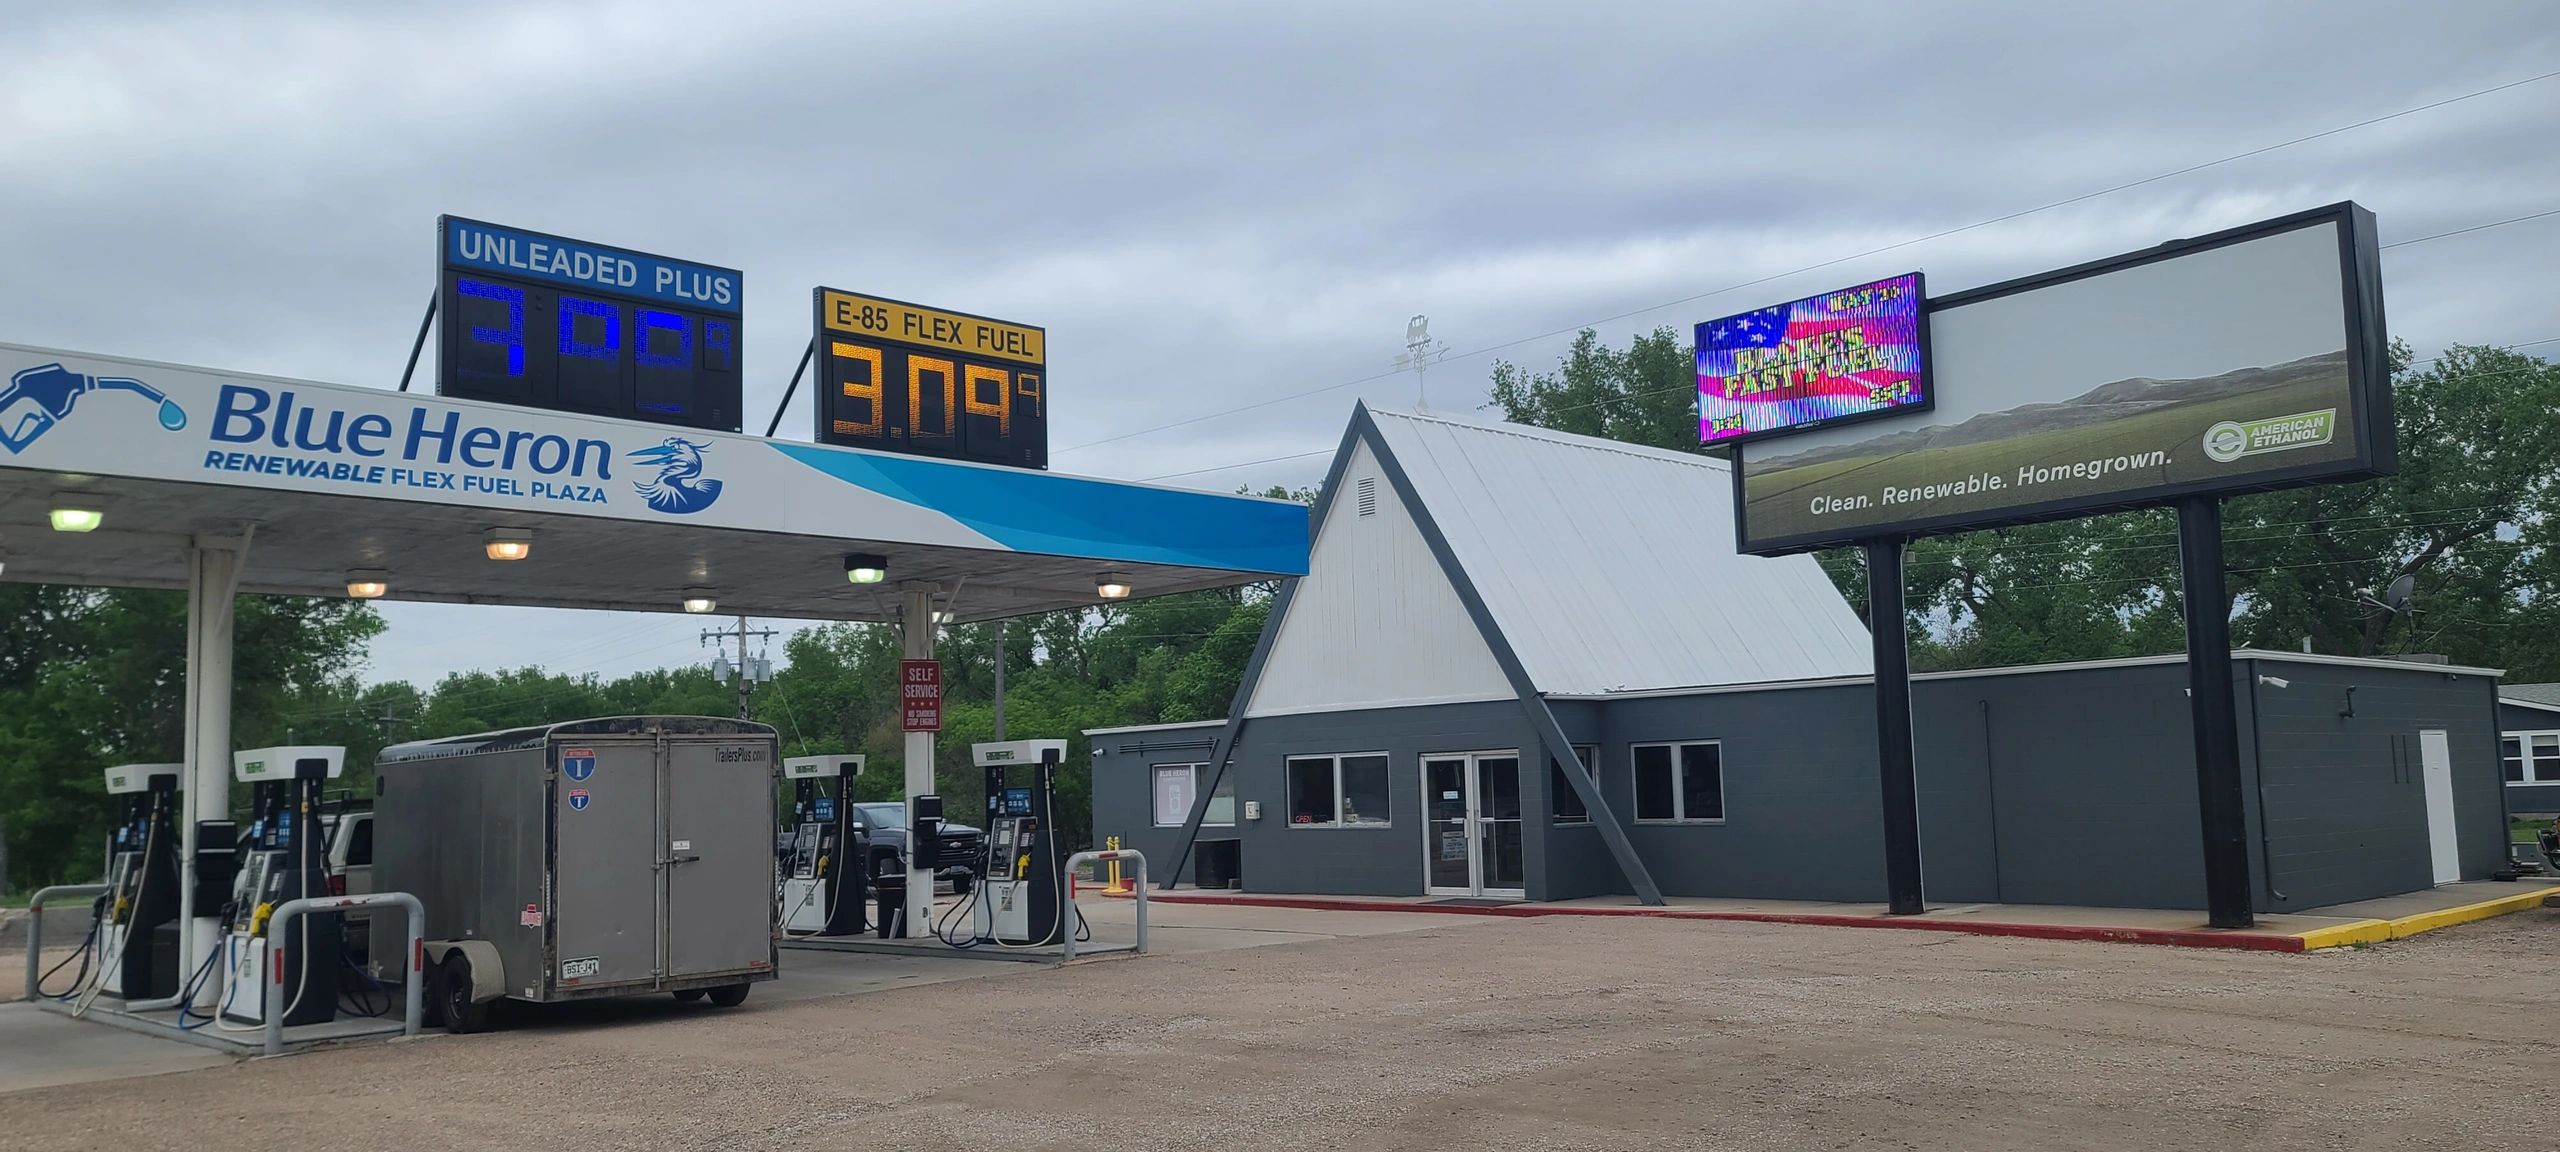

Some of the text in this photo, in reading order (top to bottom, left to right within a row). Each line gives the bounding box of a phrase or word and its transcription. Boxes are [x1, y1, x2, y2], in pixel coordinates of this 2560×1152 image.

[459, 229, 732, 305] UNLEADED PLUS
[836, 300, 1034, 357] E-85 FLEX FUEL
[209, 384, 612, 480] Blue Heron
[2250, 416, 2325, 438] AMERICAN
[2253, 428, 2320, 448] ETHANOL
[203, 450, 608, 504] RENEWABLE FLEX FUEL PLAZA
[1810, 450, 2172, 515] Clean. Renewable. Homegrown.
[904, 684, 938, 698] SERVICE
[908, 667, 933, 681] SELF
[715, 746, 767, 763] TrailersPlus.com
